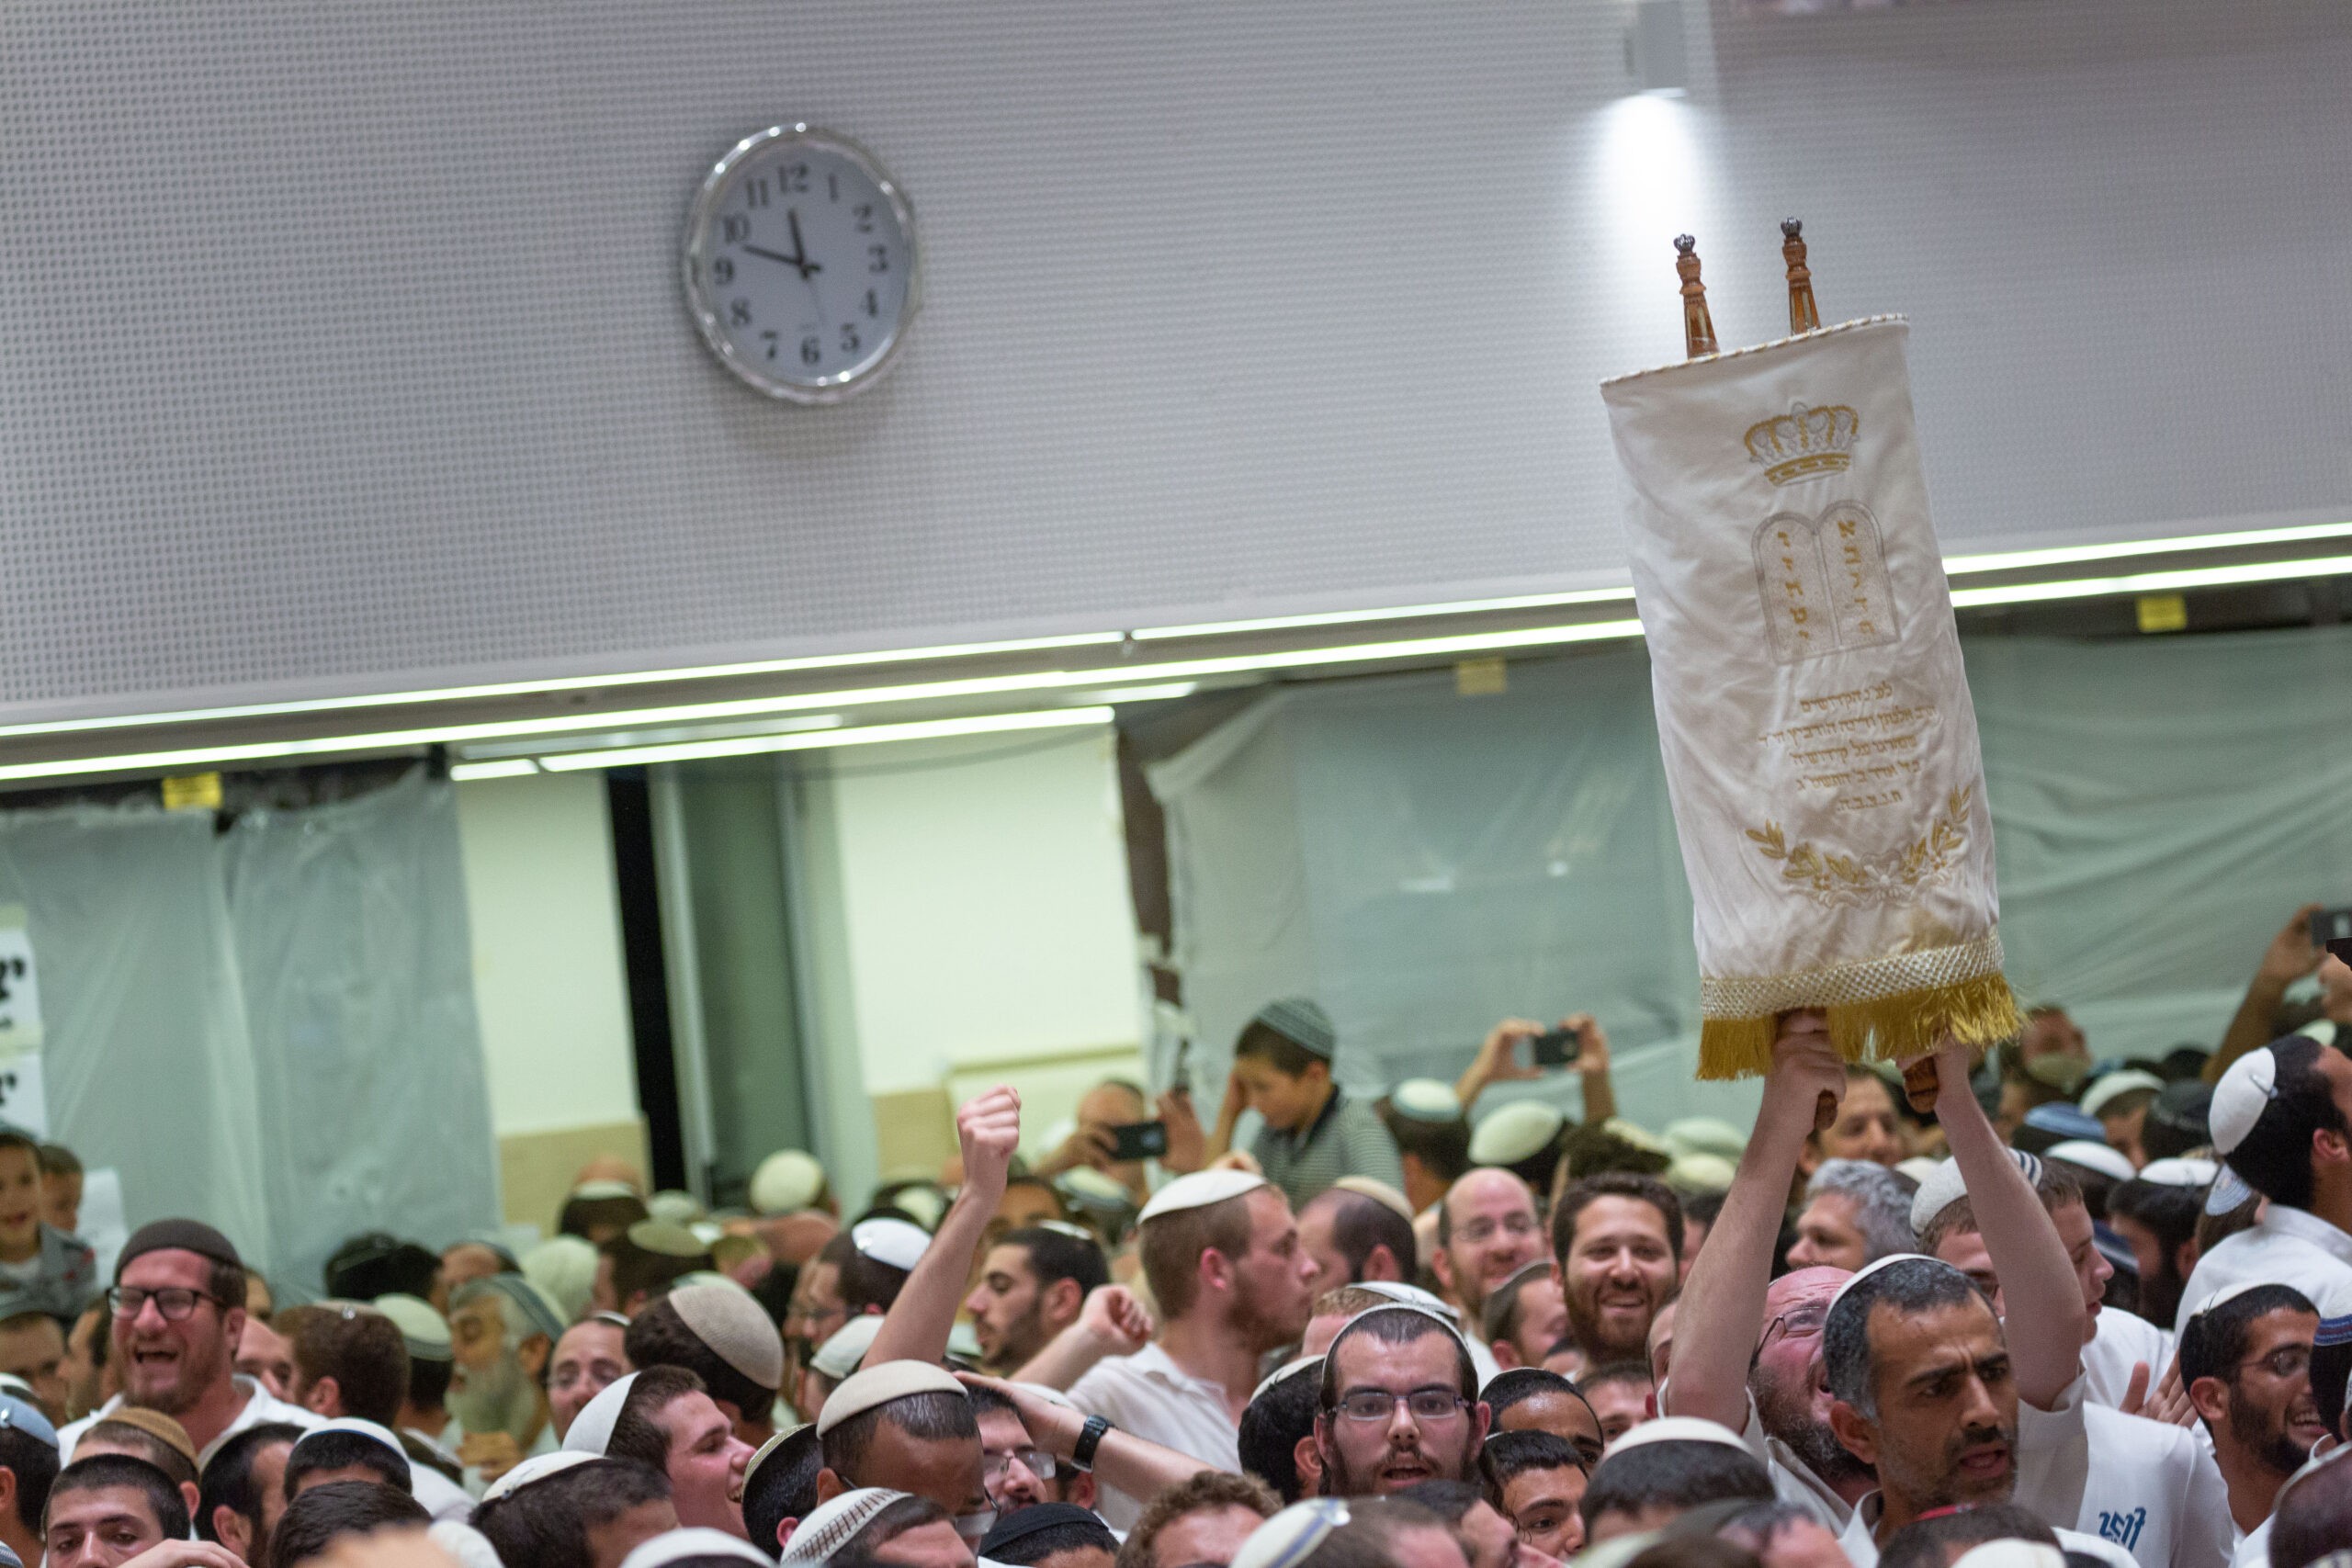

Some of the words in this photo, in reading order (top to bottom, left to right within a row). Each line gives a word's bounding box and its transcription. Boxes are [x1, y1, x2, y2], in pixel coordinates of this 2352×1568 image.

[778, 162, 808, 194] 12
[746, 179, 769, 209] 11
[724, 210, 750, 243] 10
[854, 204, 872, 233] 2
[714, 257, 734, 287] 9
[869, 245, 888, 272] 3
[731, 299, 752, 325] 8
[861, 288, 878, 320] 4
[760, 330, 778, 360] 7
[800, 336, 820, 365] 6
[840, 323, 861, 354] 5
